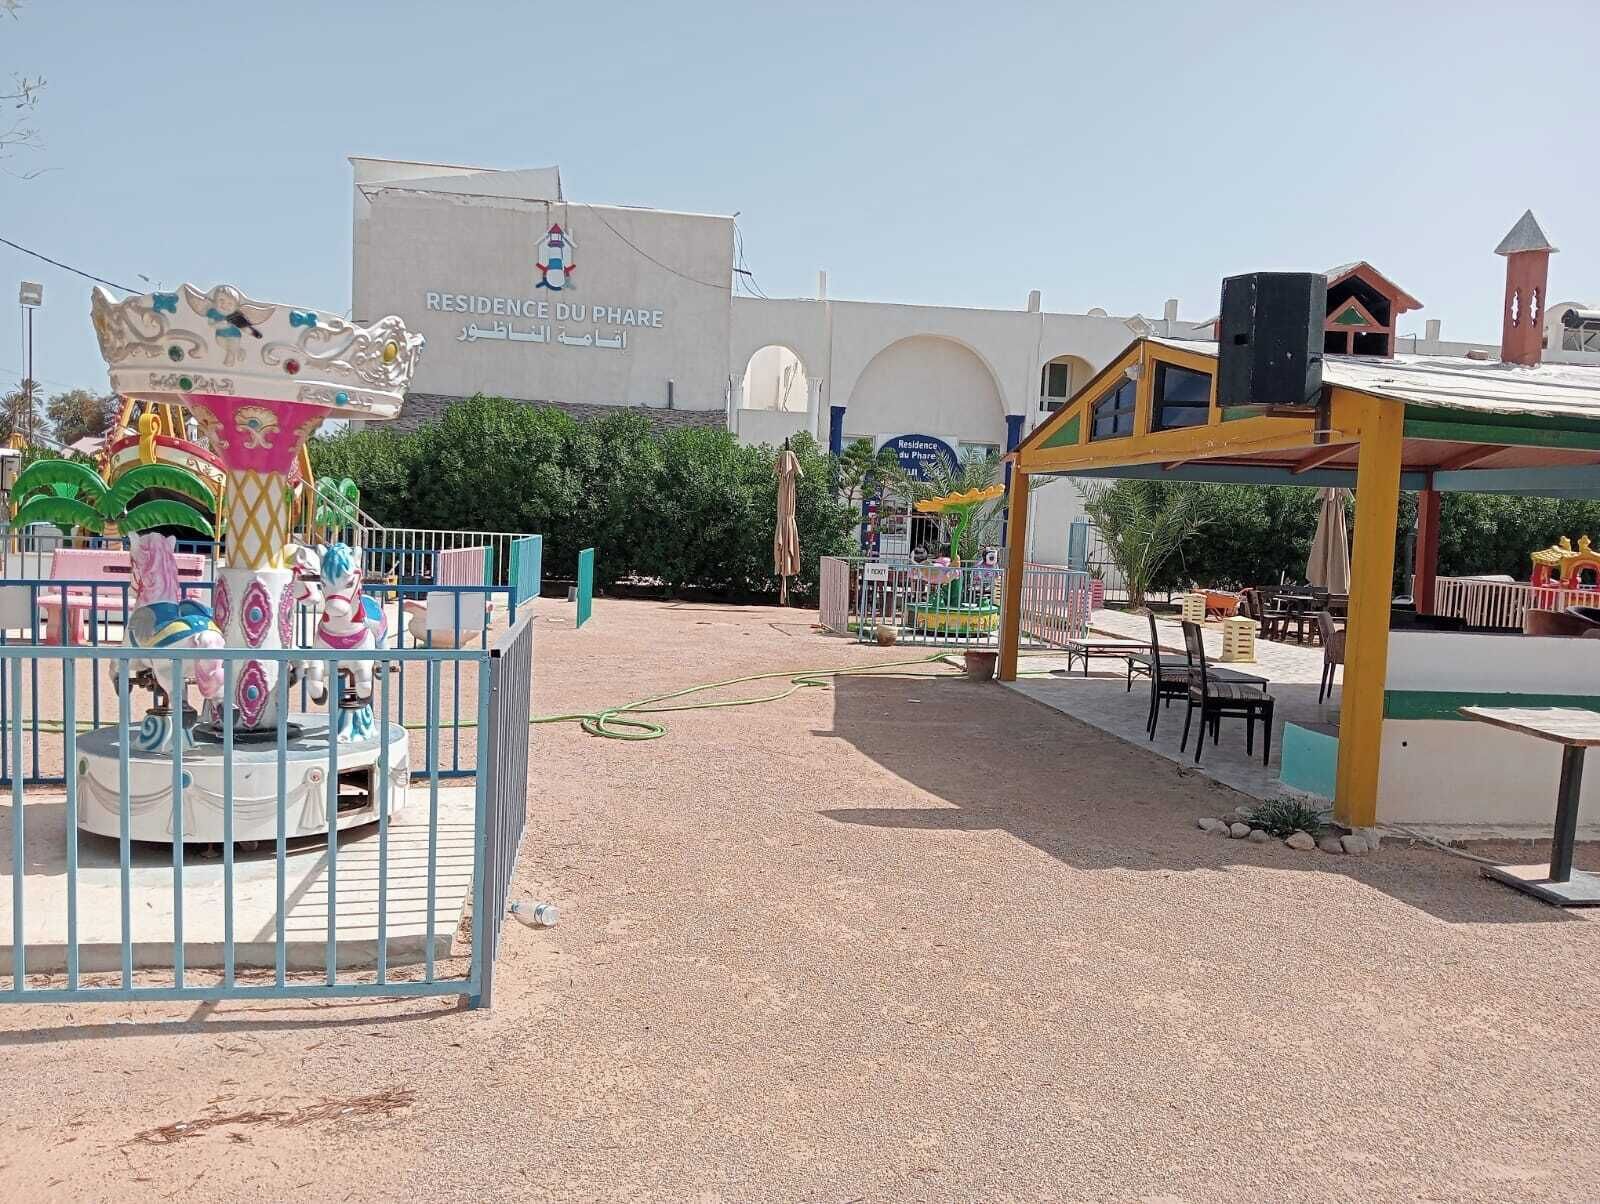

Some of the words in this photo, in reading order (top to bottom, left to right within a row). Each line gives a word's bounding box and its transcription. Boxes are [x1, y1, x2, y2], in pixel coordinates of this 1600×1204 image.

[427, 292, 549, 318] RESIDENCE
[556, 303, 586, 321] DU
[592, 306, 664, 328] PHARE
[898, 439, 938, 450] Residence
[899, 450, 909, 459] du
[911, 451, 936, 460] Phare
